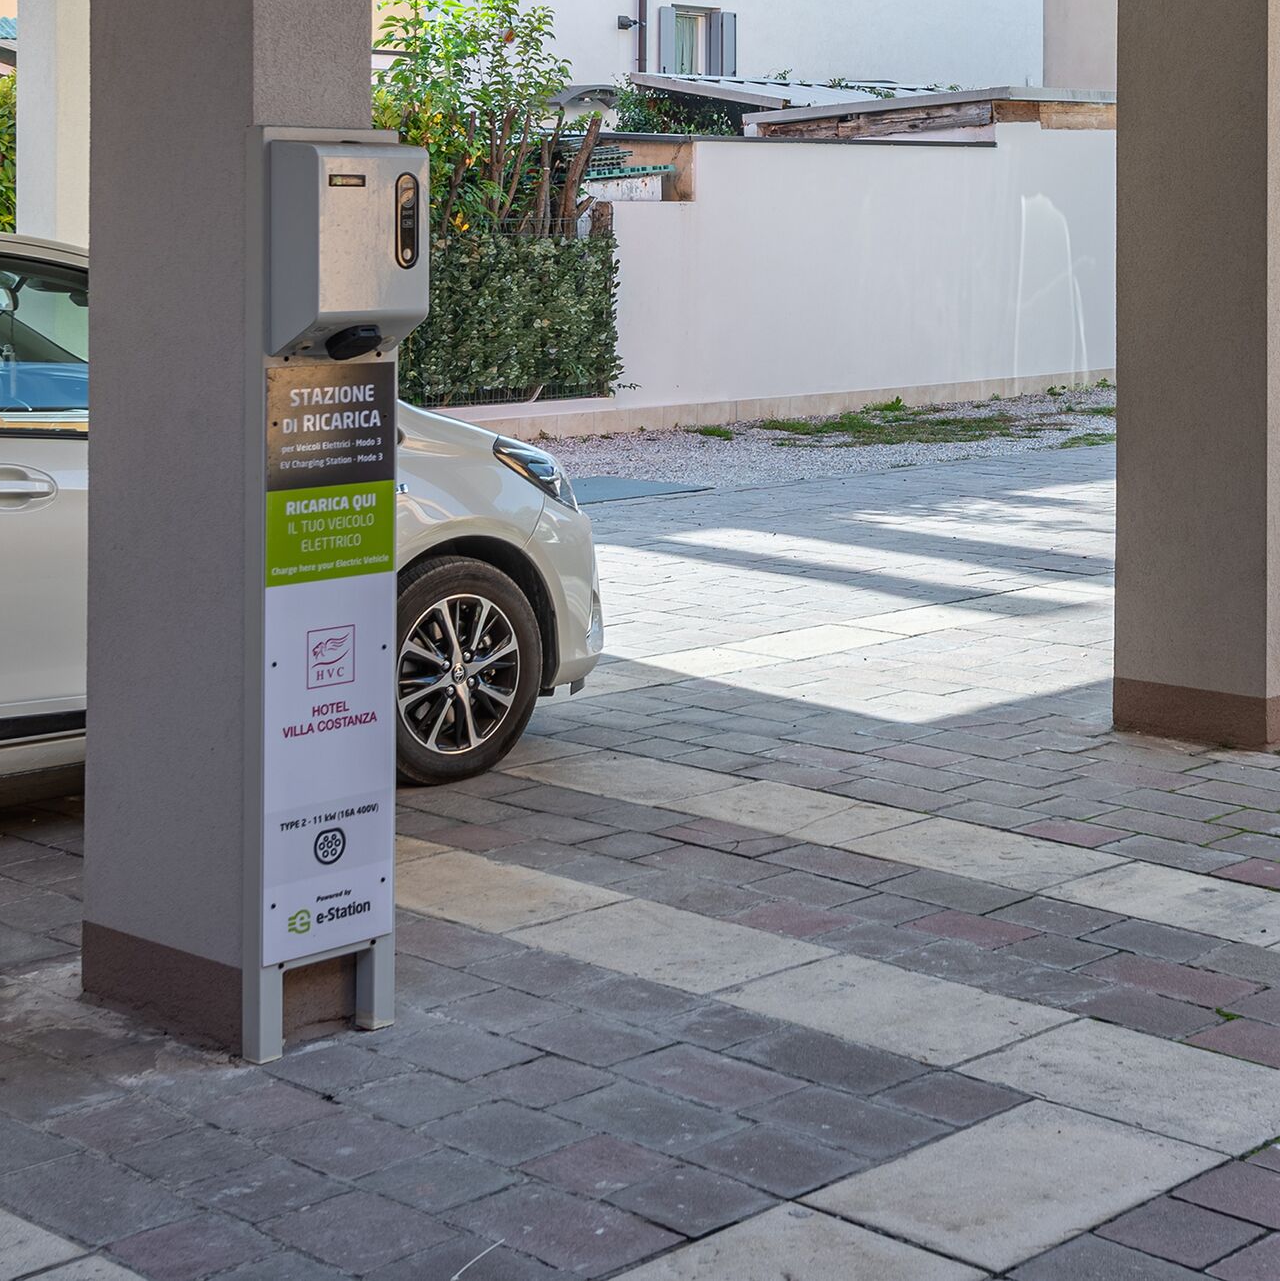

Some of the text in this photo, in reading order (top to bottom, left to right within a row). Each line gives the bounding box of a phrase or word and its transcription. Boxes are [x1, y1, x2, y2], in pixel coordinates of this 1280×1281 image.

[289, 384, 375, 407] STAZIONE
[282, 409, 382, 434] DI RICARICA
[281, 445, 295, 455] per
[296, 442, 321, 452] Veicoli
[322, 439, 351, 450] Elettrici
[355, 438, 376, 447] Modo
[376, 437, 382, 446] 3
[280, 460, 291, 470] EV
[292, 458, 325, 469] Charging
[326, 456, 352, 466] Station
[357, 453, 376, 463] Mode
[378, 452, 383, 461] 3
[286, 493, 376, 516] RICARICA QUI
[288, 513, 375, 535] IL TUO VEICOLO
[301, 533, 362, 552] ELETTRICO
[271, 554, 389, 576] Charge here your Electric Vehicle
[312, 701, 350, 717] HOTEL
[282, 711, 378, 738] VILLA COSTANZA
[280, 820, 300, 831] TYPE
[301, 818, 307, 827] 2
[313, 815, 322, 824] 11
[324, 812, 337, 822] kW
[337, 808, 355, 821] (16A
[356, 802, 379, 815] 400V)
[316, 888, 352, 903] Powered by
[316, 900, 371, 924] e-Station
